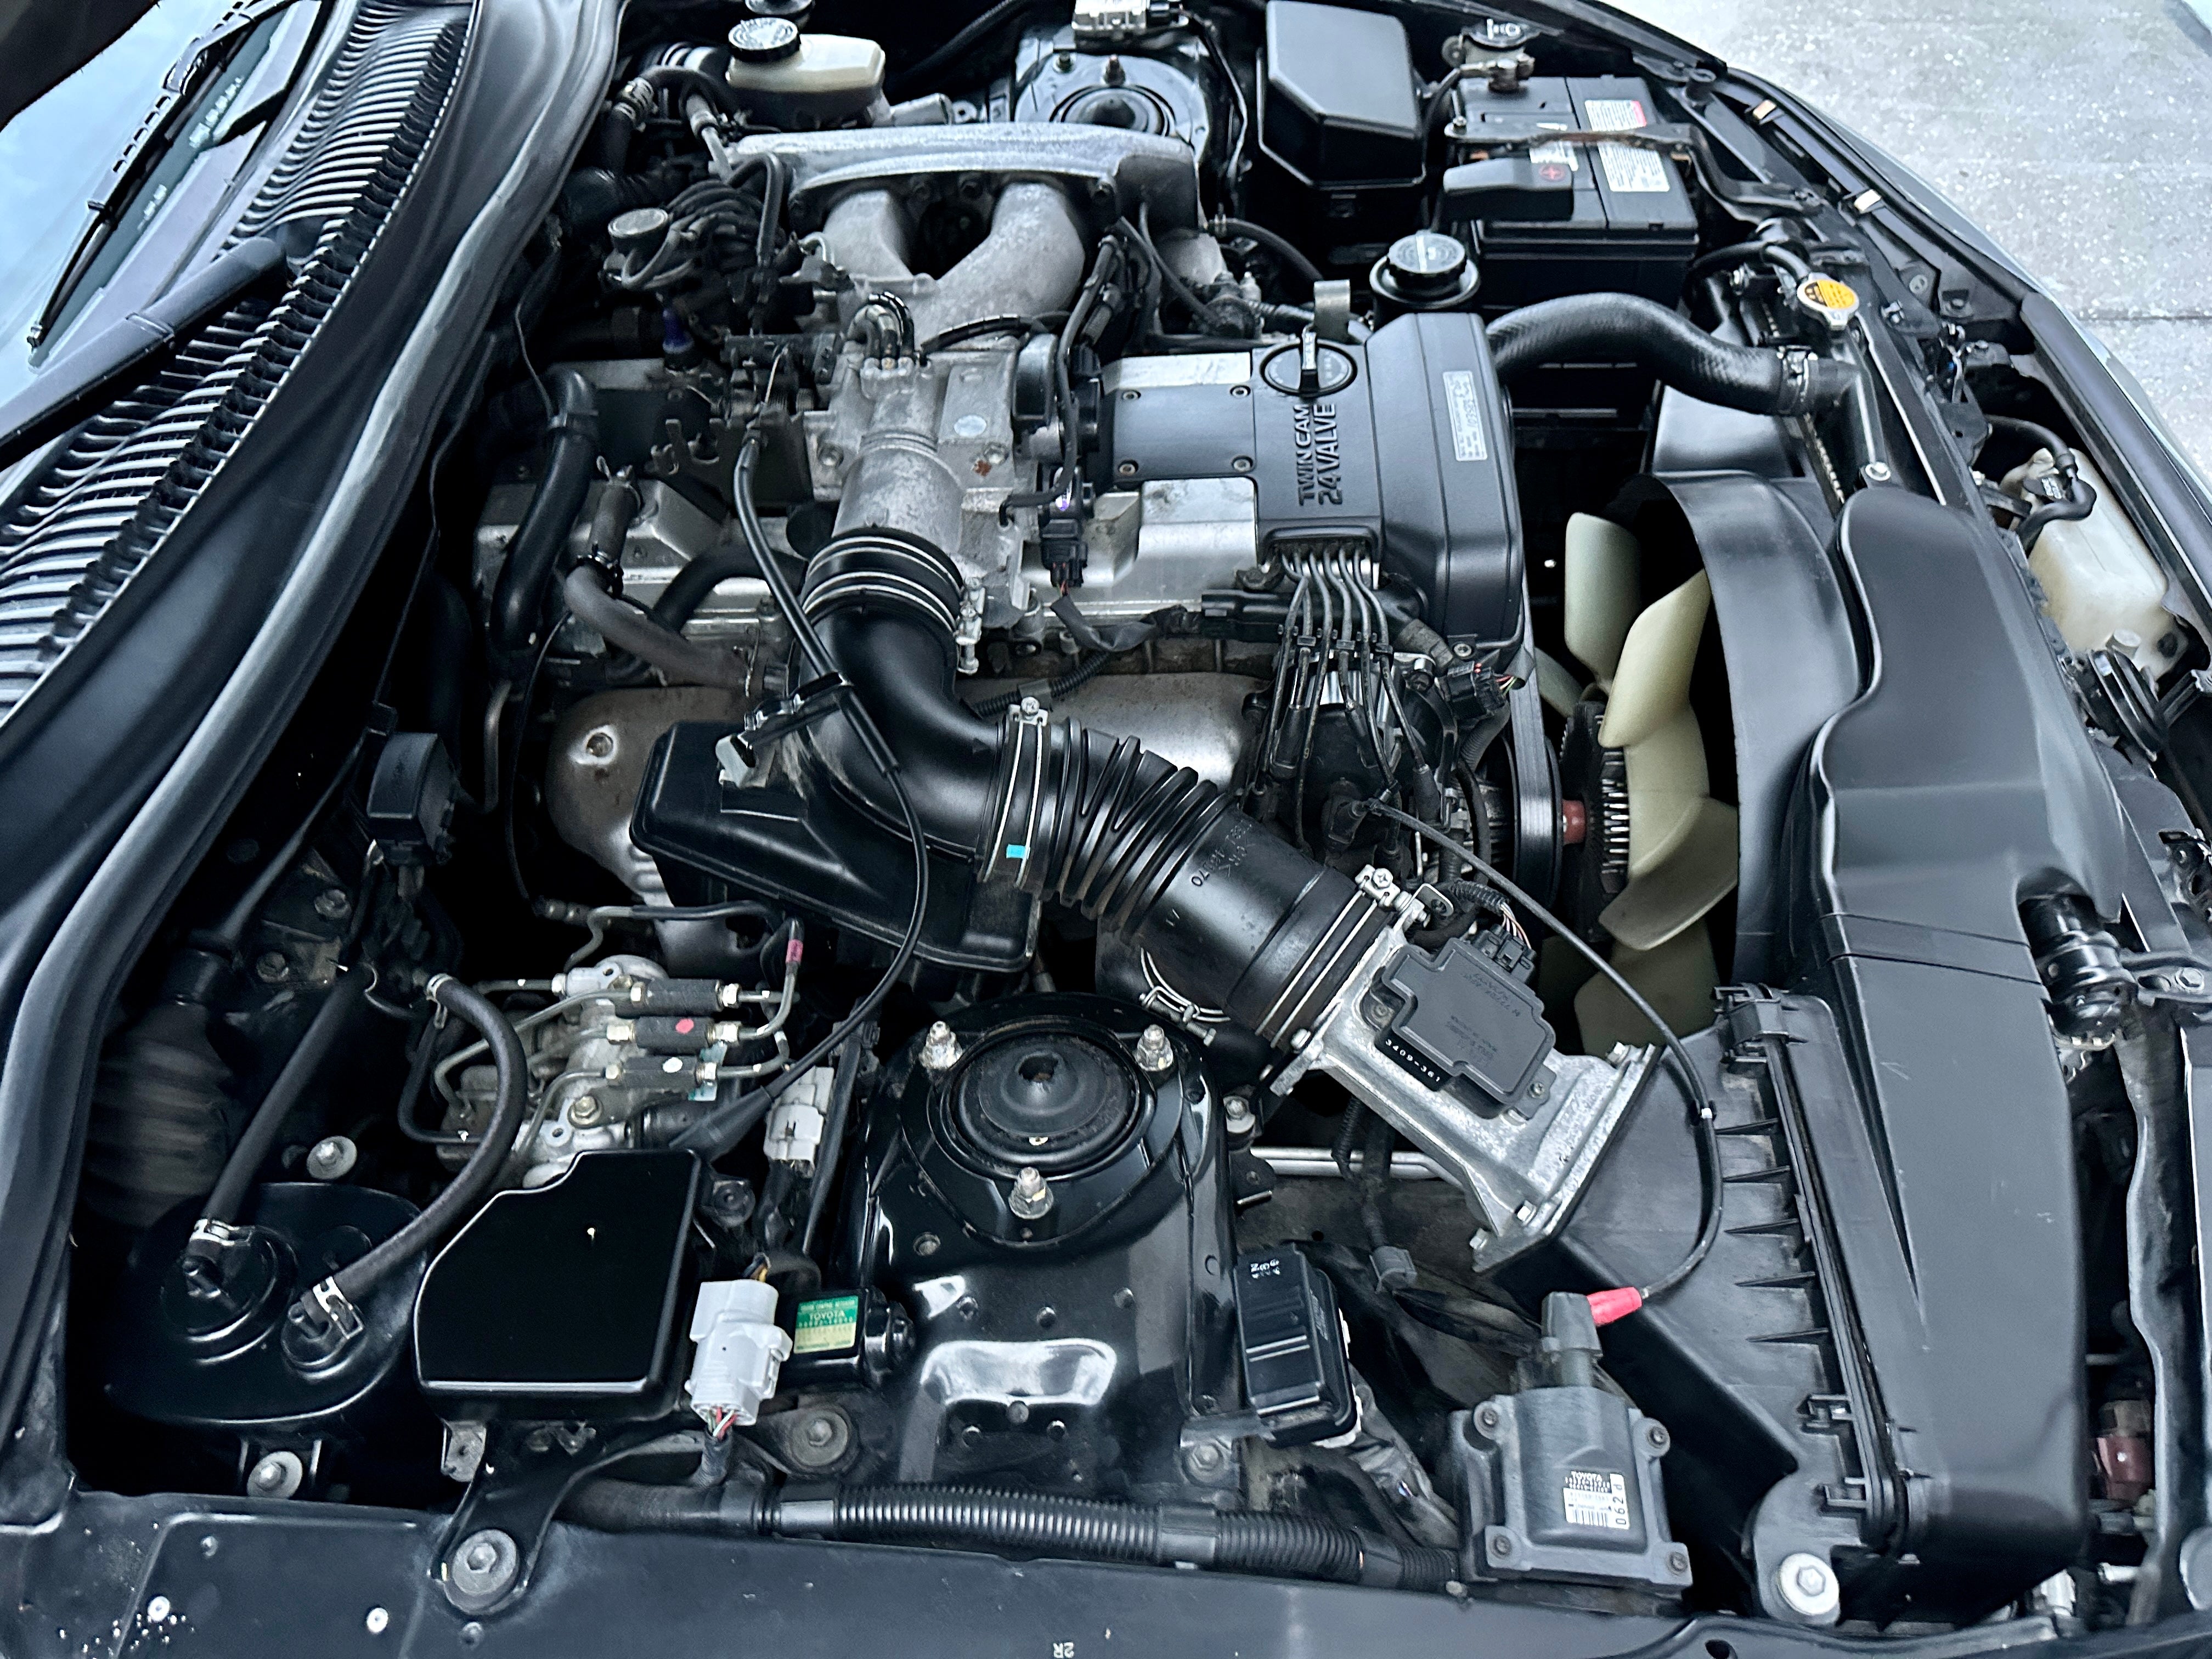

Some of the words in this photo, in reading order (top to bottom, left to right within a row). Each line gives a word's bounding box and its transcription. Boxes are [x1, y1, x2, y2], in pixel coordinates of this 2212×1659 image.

[1294, 404, 1311, 447] CAM
[1296, 450, 1315, 506] TWIN
[1385, 1039, 1440, 1082] 3409-361
[809, 1310, 845, 1321] TOYOTA
[1570, 1471, 1602, 1482] TOYOTA
[1053, 1642, 1074, 1658] 2R
